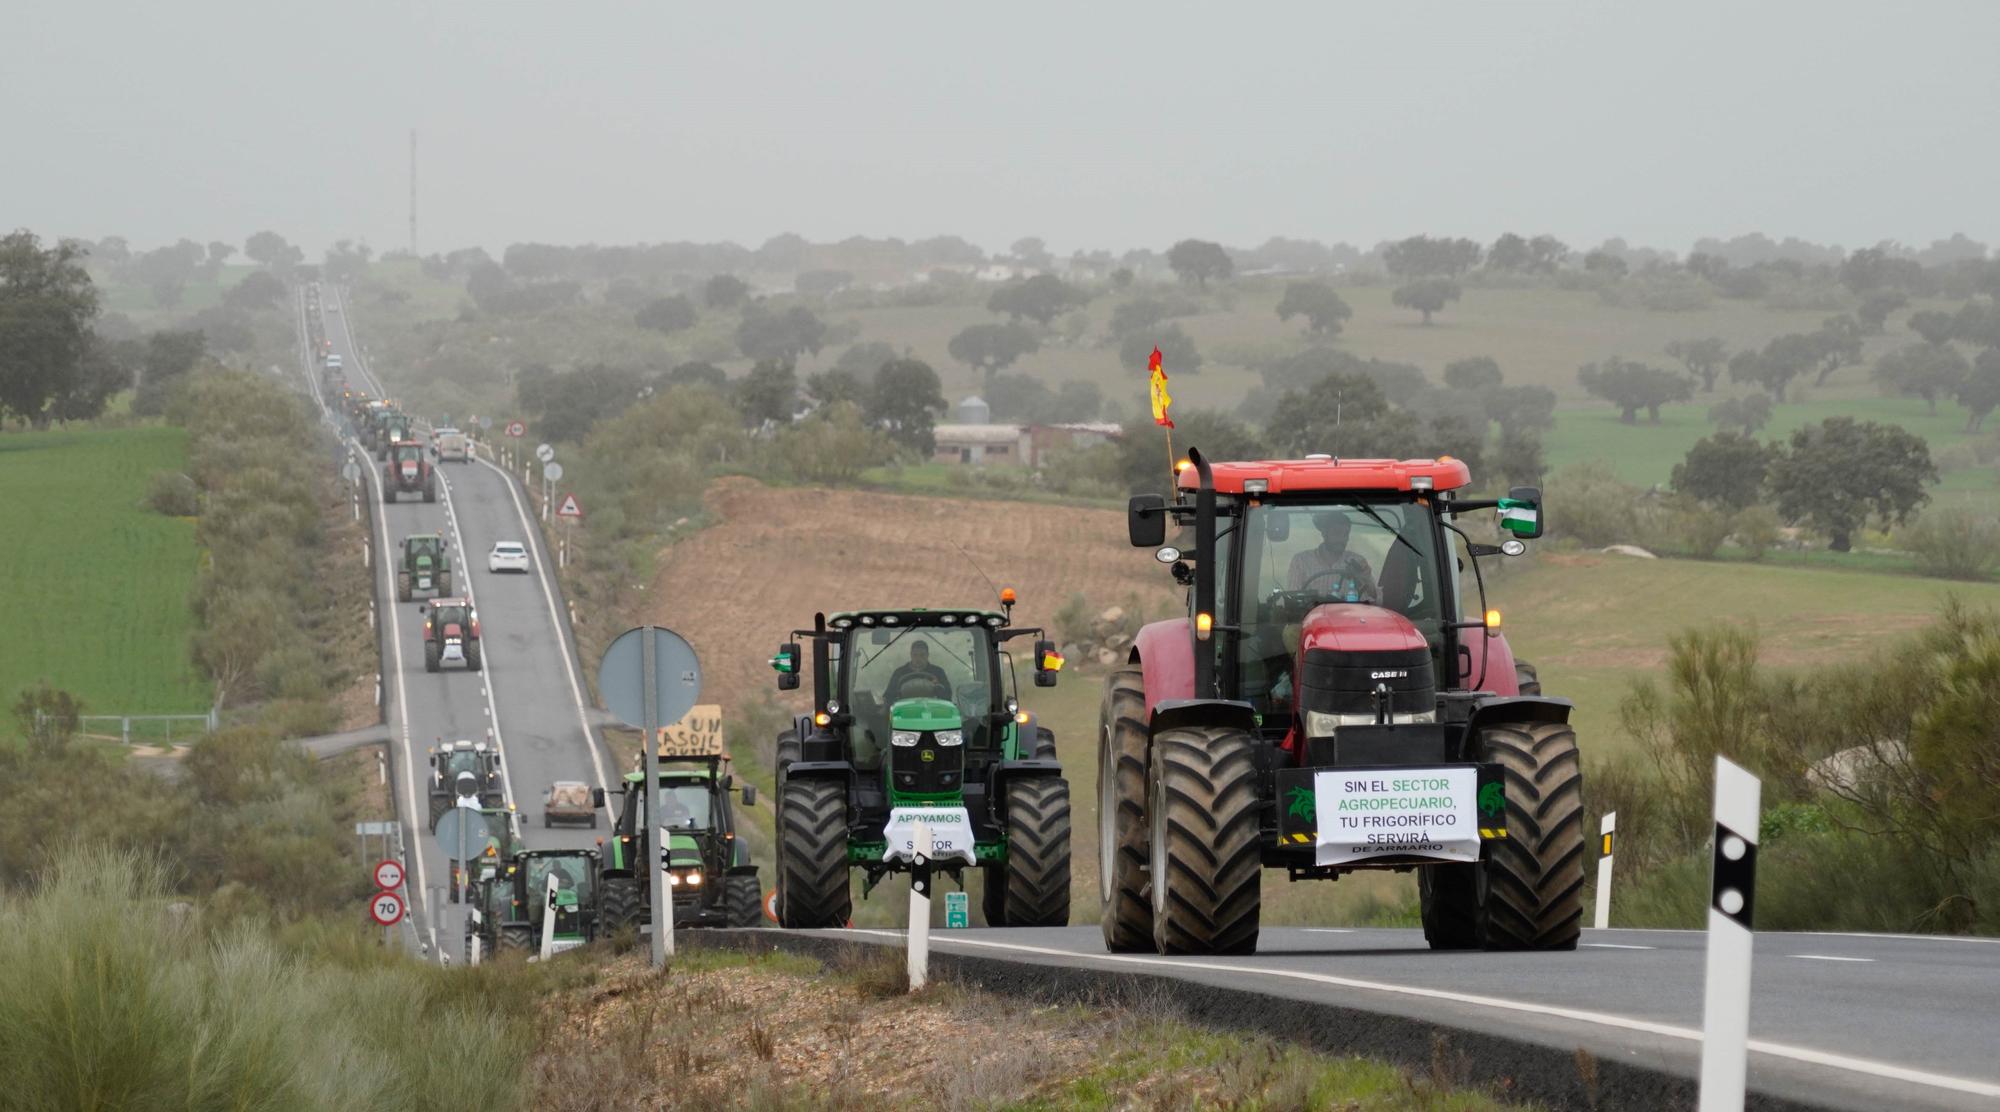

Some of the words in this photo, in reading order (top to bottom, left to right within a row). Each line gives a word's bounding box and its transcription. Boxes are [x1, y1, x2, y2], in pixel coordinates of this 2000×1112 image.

[1371, 671, 1398, 679] CASE
[692, 718, 721, 733] UN
[658, 731, 720, 750] ASOIL
[1344, 781, 1367, 793] SIN
[1371, 780, 1389, 792] EL
[1392, 778, 1450, 792] SECTOR
[1338, 796, 1457, 811] AGROPECUARIO,
[1340, 817, 1358, 828] TU
[1363, 813, 1456, 828] FRIGORÍFICO
[906, 840, 953, 850] STOR
[1367, 830, 1430, 845] SERVIRÁ
[1376, 843, 1443, 852] ARMARIO
[378, 903, 396, 915] 70
